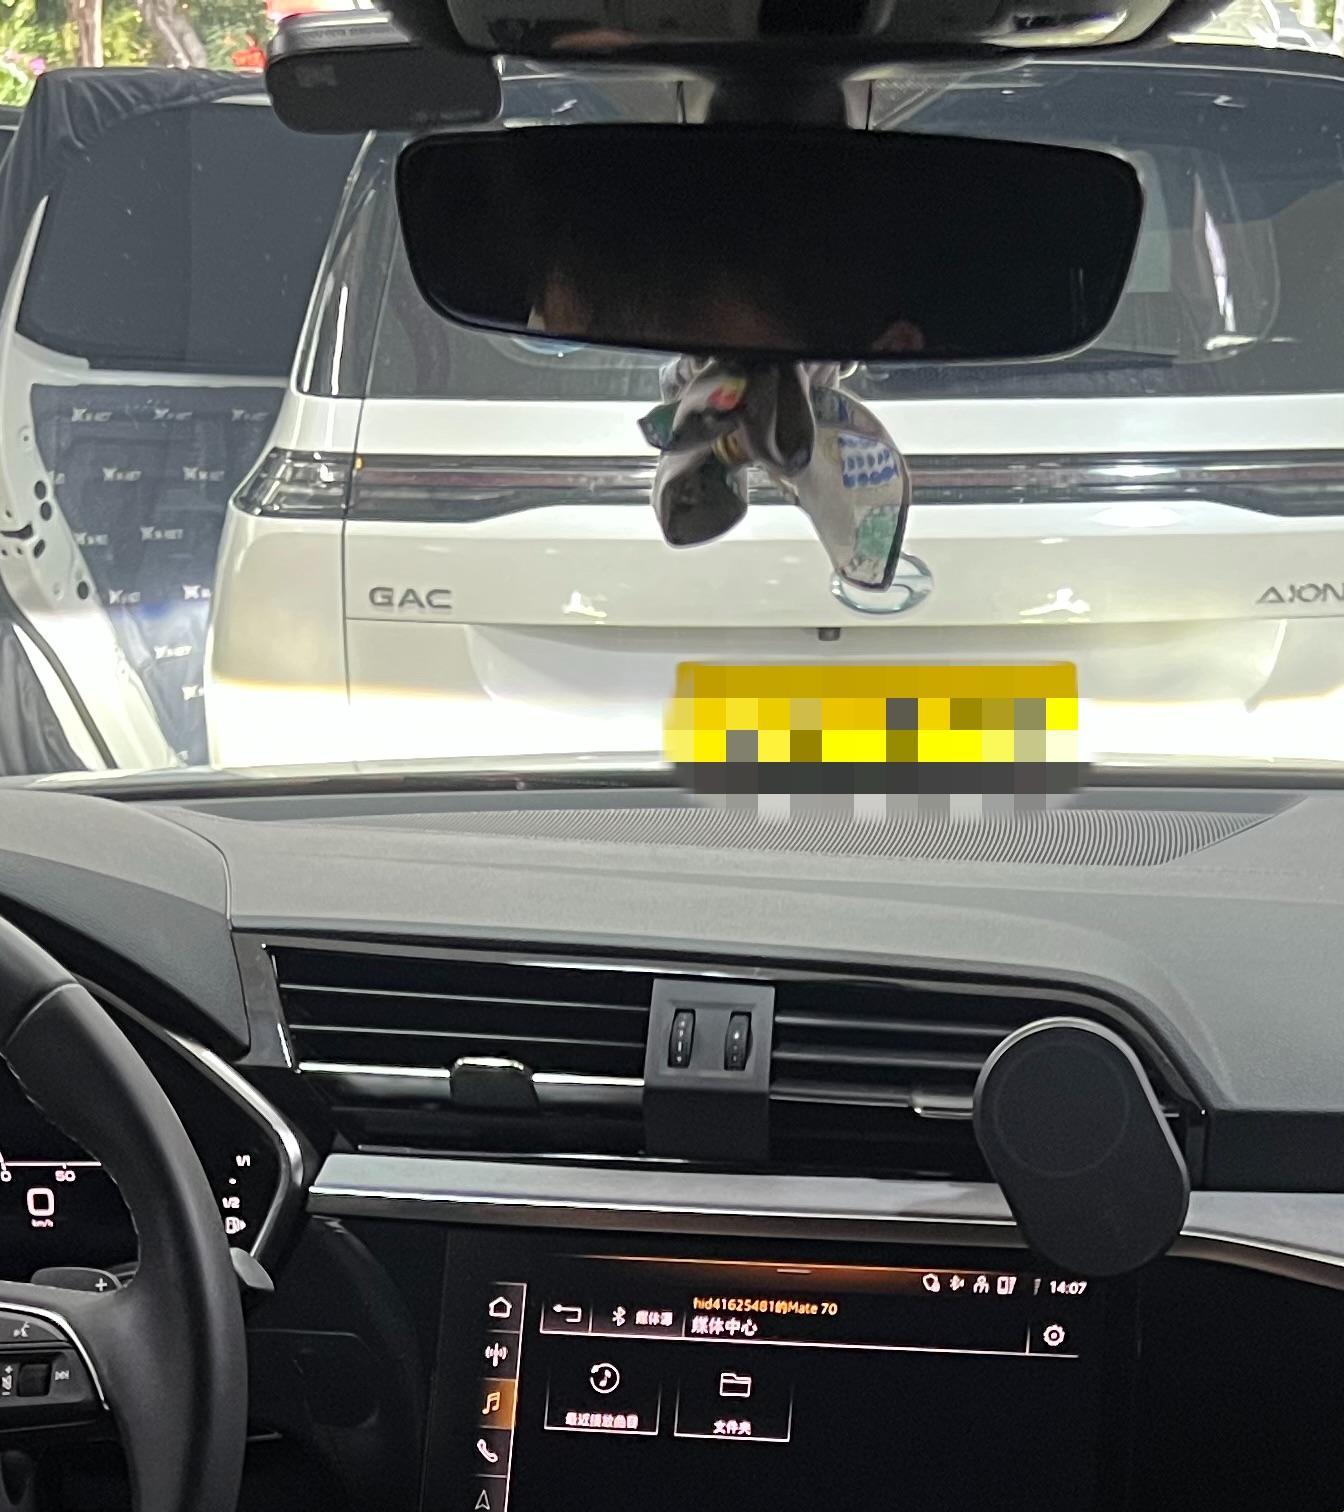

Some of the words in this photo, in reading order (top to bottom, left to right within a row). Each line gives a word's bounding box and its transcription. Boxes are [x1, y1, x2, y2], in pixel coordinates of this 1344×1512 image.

[368, 586, 453, 610] GAC
[1, 1170, 12, 1182] 0
[27, 1188, 55, 1216] 0
[1049, 1281, 1087, 1296] 14:07
[821, 1303, 838, 1316] 70
[691, 1315, 757, 1337] 媒体中心
[713, 1419, 751, 1436] 文件夹
